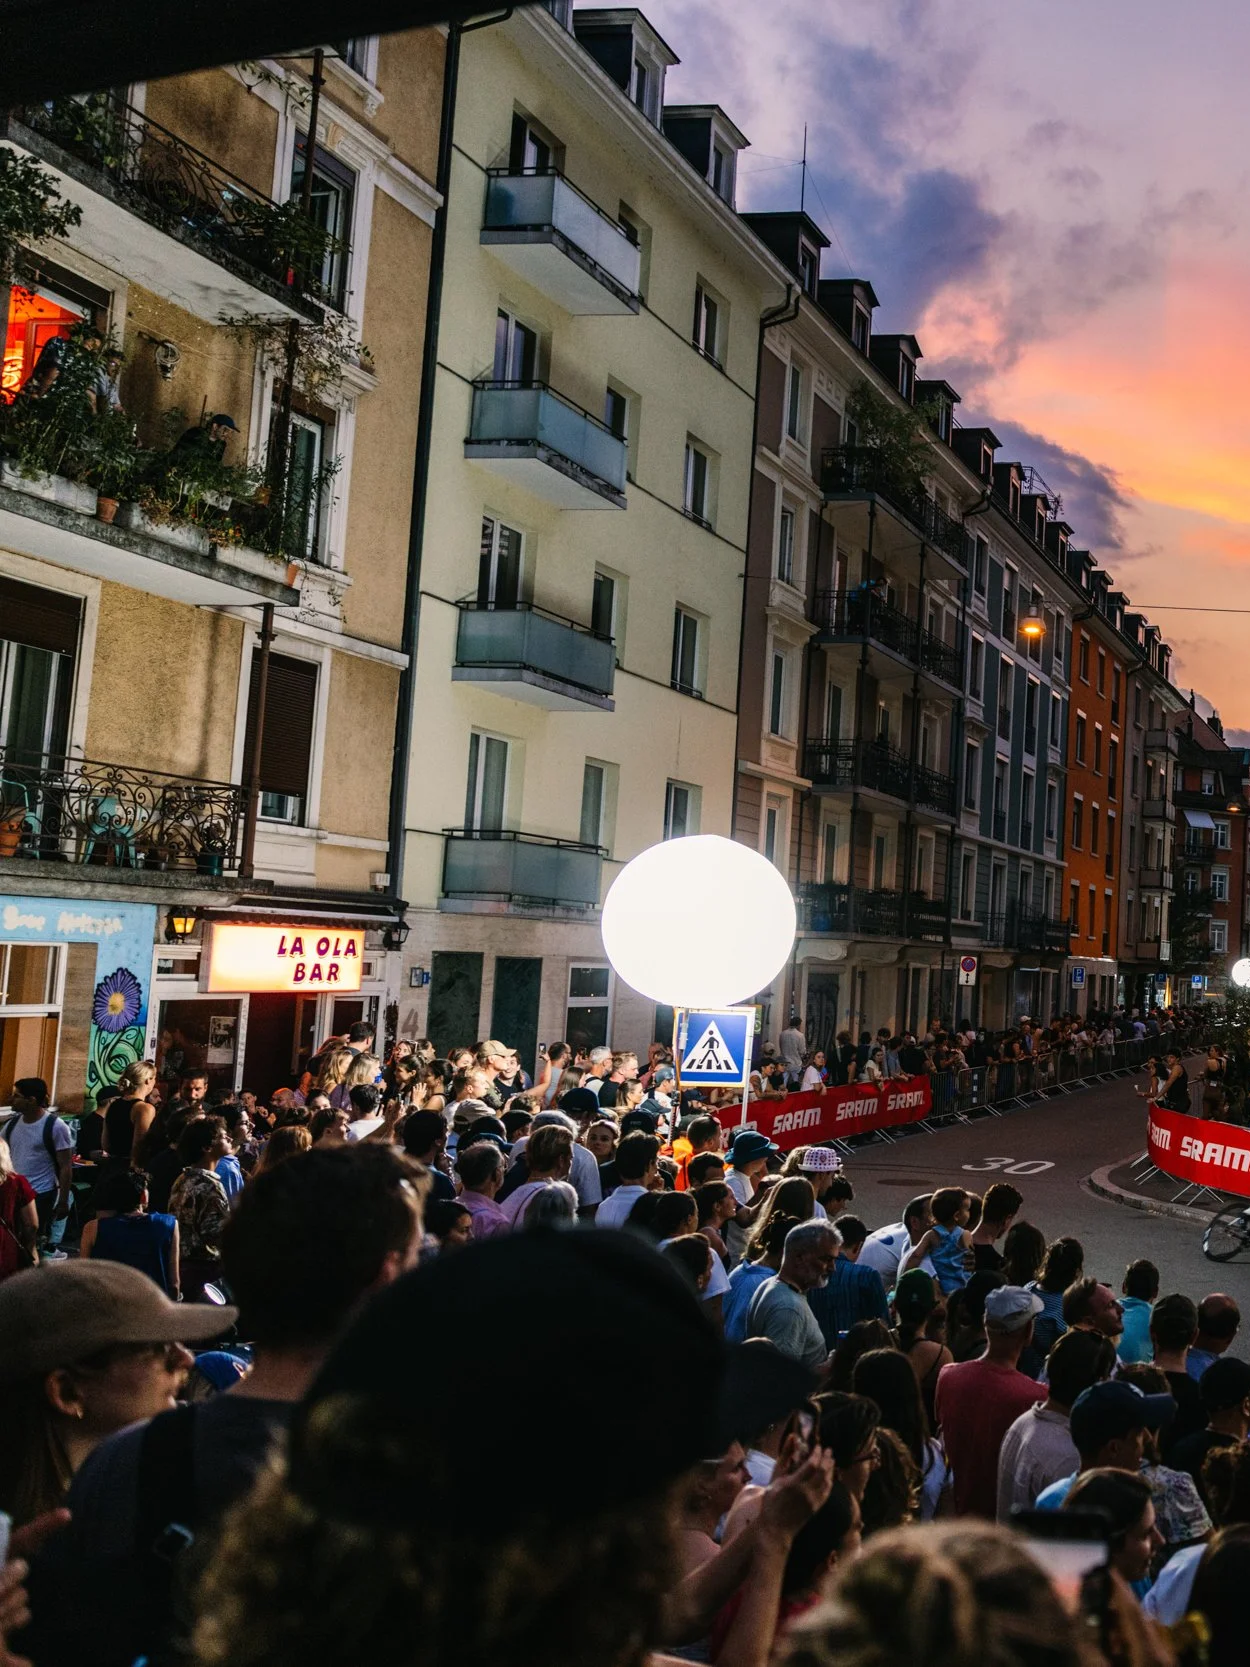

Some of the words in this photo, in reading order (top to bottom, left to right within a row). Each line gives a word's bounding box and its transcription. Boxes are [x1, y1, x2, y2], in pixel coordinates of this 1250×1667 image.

[277, 935, 305, 957] LA
[316, 937, 358, 958] OLA
[293, 962, 340, 984] BAR
[836, 1098, 878, 1121] SRAM
[887, 1091, 924, 1111] SRAM
[772, 1107, 821, 1135] SRAM
[962, 1157, 1055, 1175] 30
